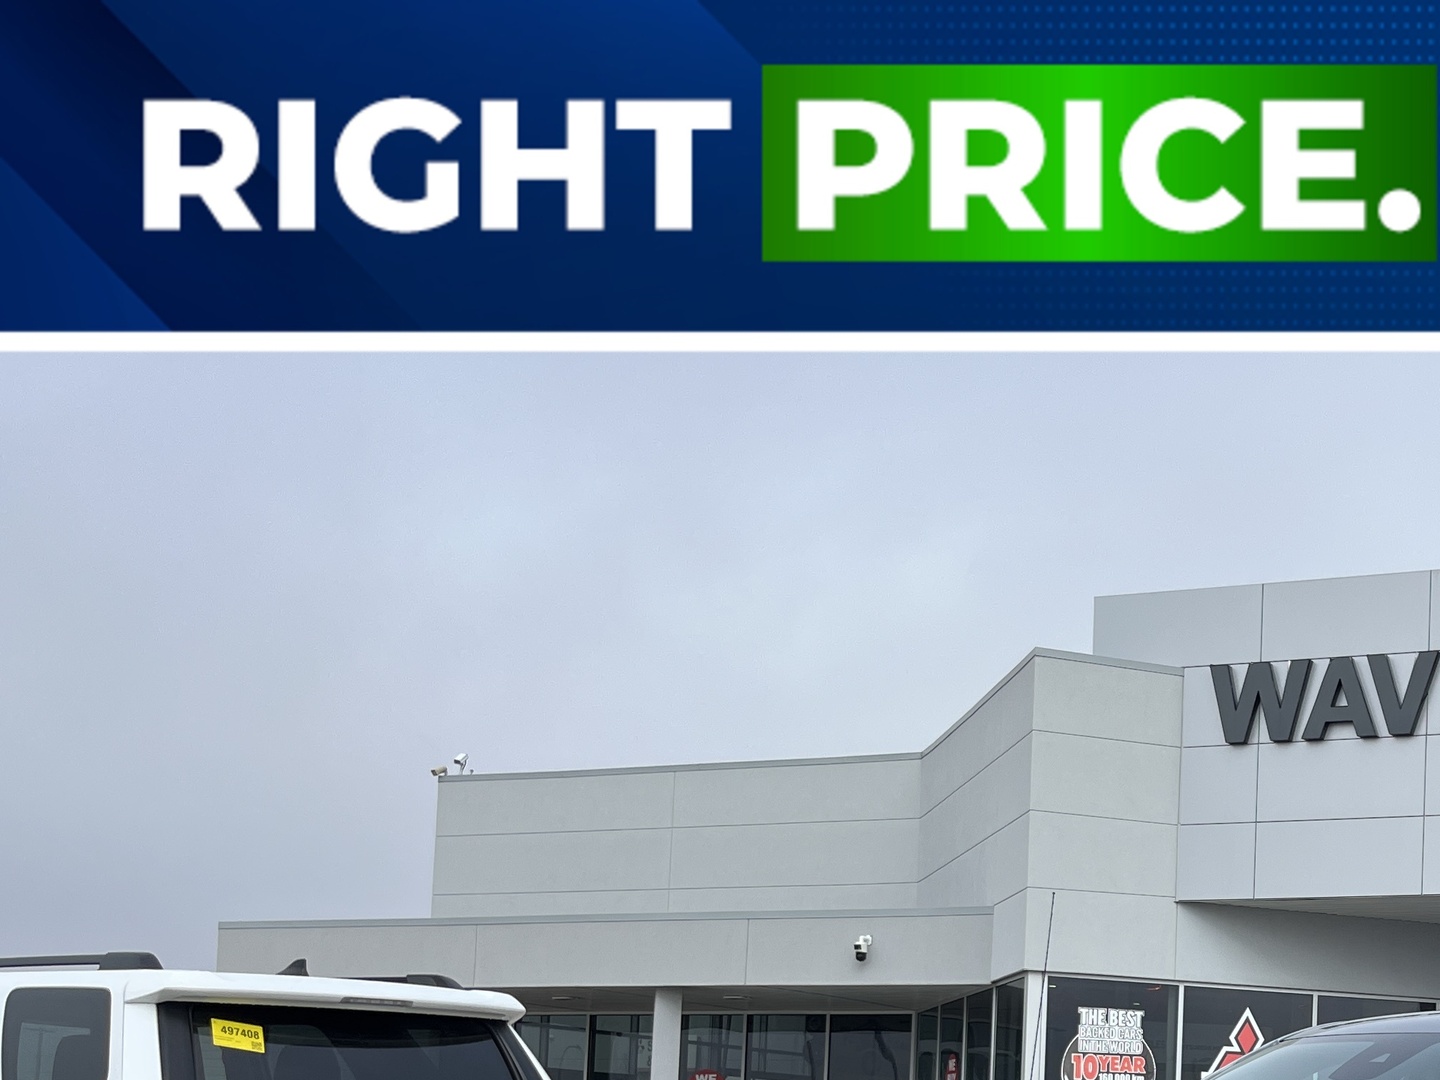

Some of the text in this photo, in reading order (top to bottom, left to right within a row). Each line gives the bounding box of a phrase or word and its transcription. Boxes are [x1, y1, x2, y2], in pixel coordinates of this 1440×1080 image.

[1079, 1007, 1144, 1028] THE BEST
[220, 1025, 260, 1040] 497408
[1080, 1026, 1144, 1040] BACKED CARS
[1079, 1040, 1144, 1054] IN THE WORLD
[1072, 1053, 1146, 1080] 10 YEAR
